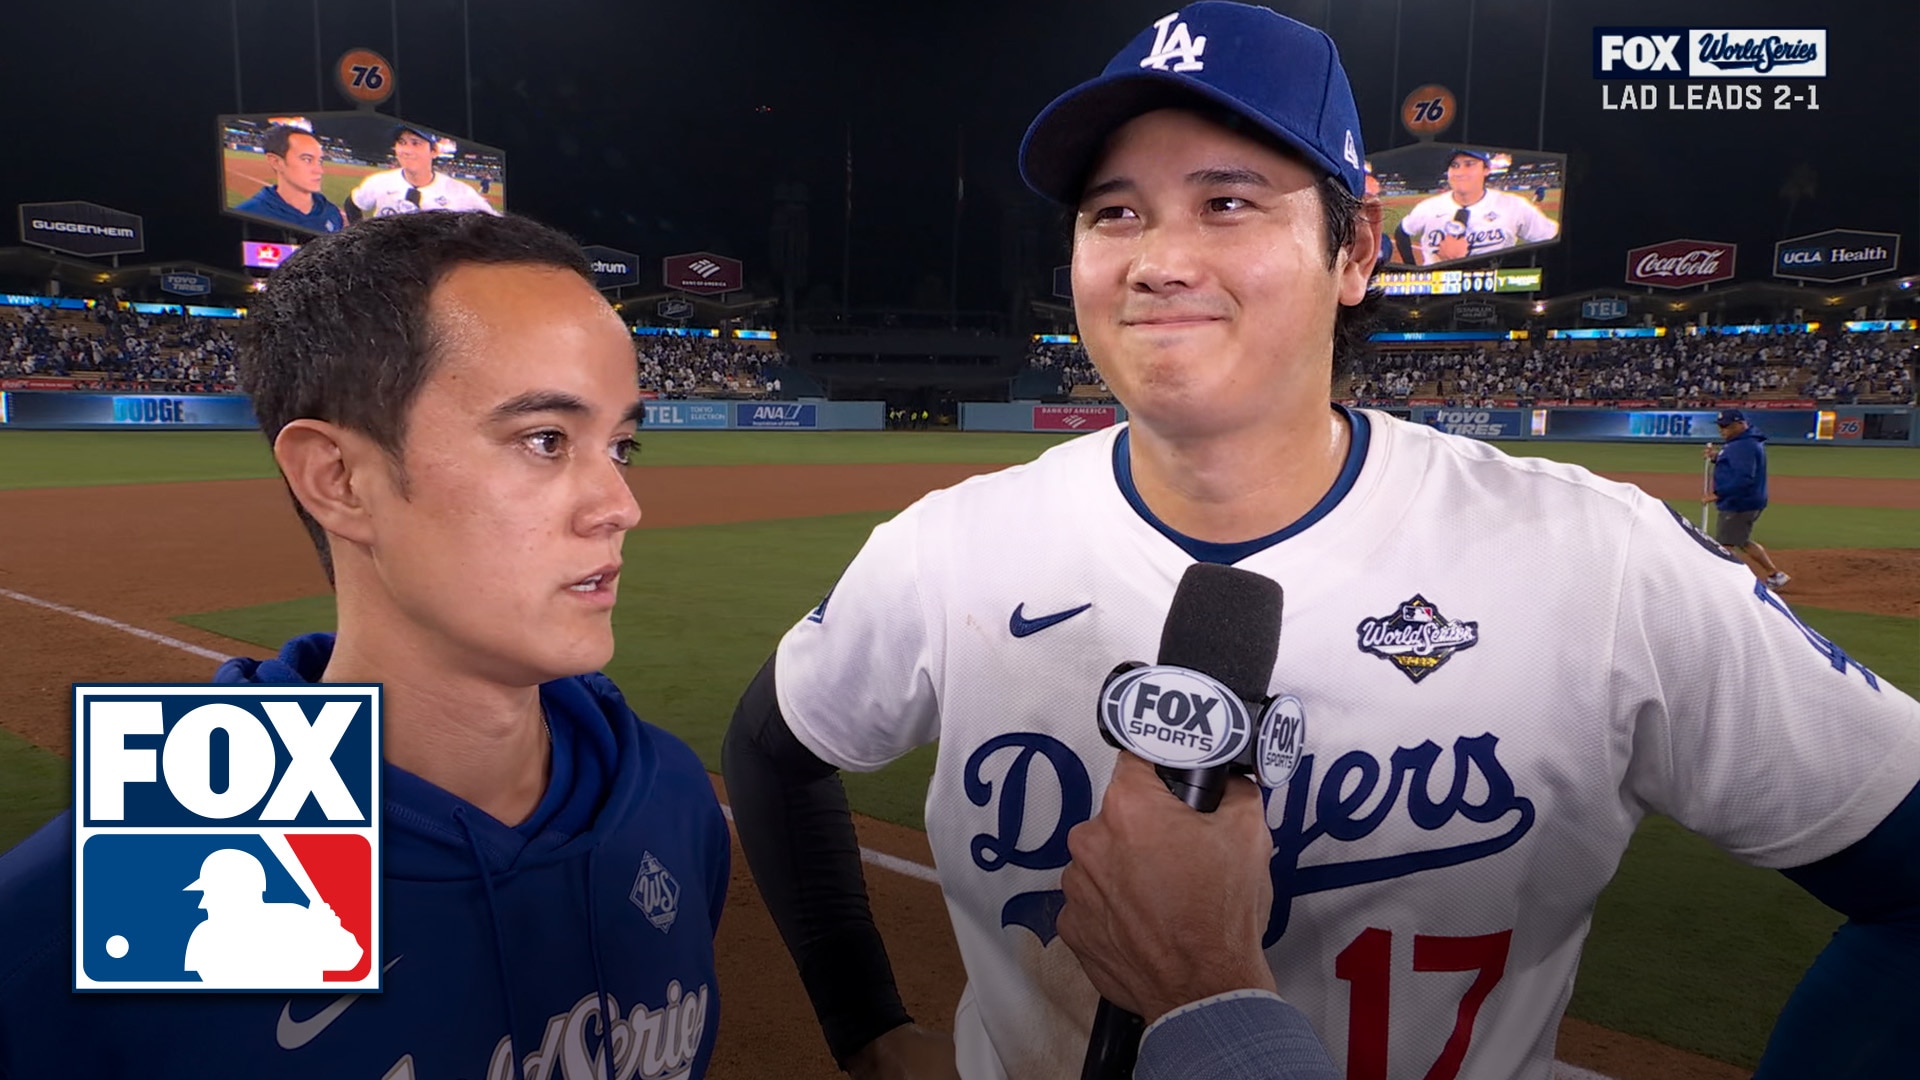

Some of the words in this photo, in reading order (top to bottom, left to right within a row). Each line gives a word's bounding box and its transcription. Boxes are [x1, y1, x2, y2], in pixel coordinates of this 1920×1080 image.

[1140, 12, 1207, 72] LA
[349, 64, 385, 90] 76
[1411, 96, 1445, 123] 76
[32, 219, 134, 238] GUGGENHEIM
[1428, 228, 1506, 257] Dgers
[1783, 251, 1822, 264] UCLA
[1830, 246, 1887, 262] Health
[591, 260, 627, 274] ctrum
[1636, 249, 1726, 278] Coca-Cola
[1588, 302, 1622, 316] TEL
[645, 406, 684, 423] TEL
[753, 406, 784, 419] ANA
[1445, 424, 1502, 435] TIRES
[1838, 421, 1859, 434] 76
[1133, 682, 1219, 736] FOX
[1129, 720, 1214, 752] SPORTS
[1269, 713, 1300, 754] FOX
[1265, 752, 1294, 769] SPORTS
[964, 731, 1536, 950] Dgers
[1335, 926, 1513, 1080] 17
